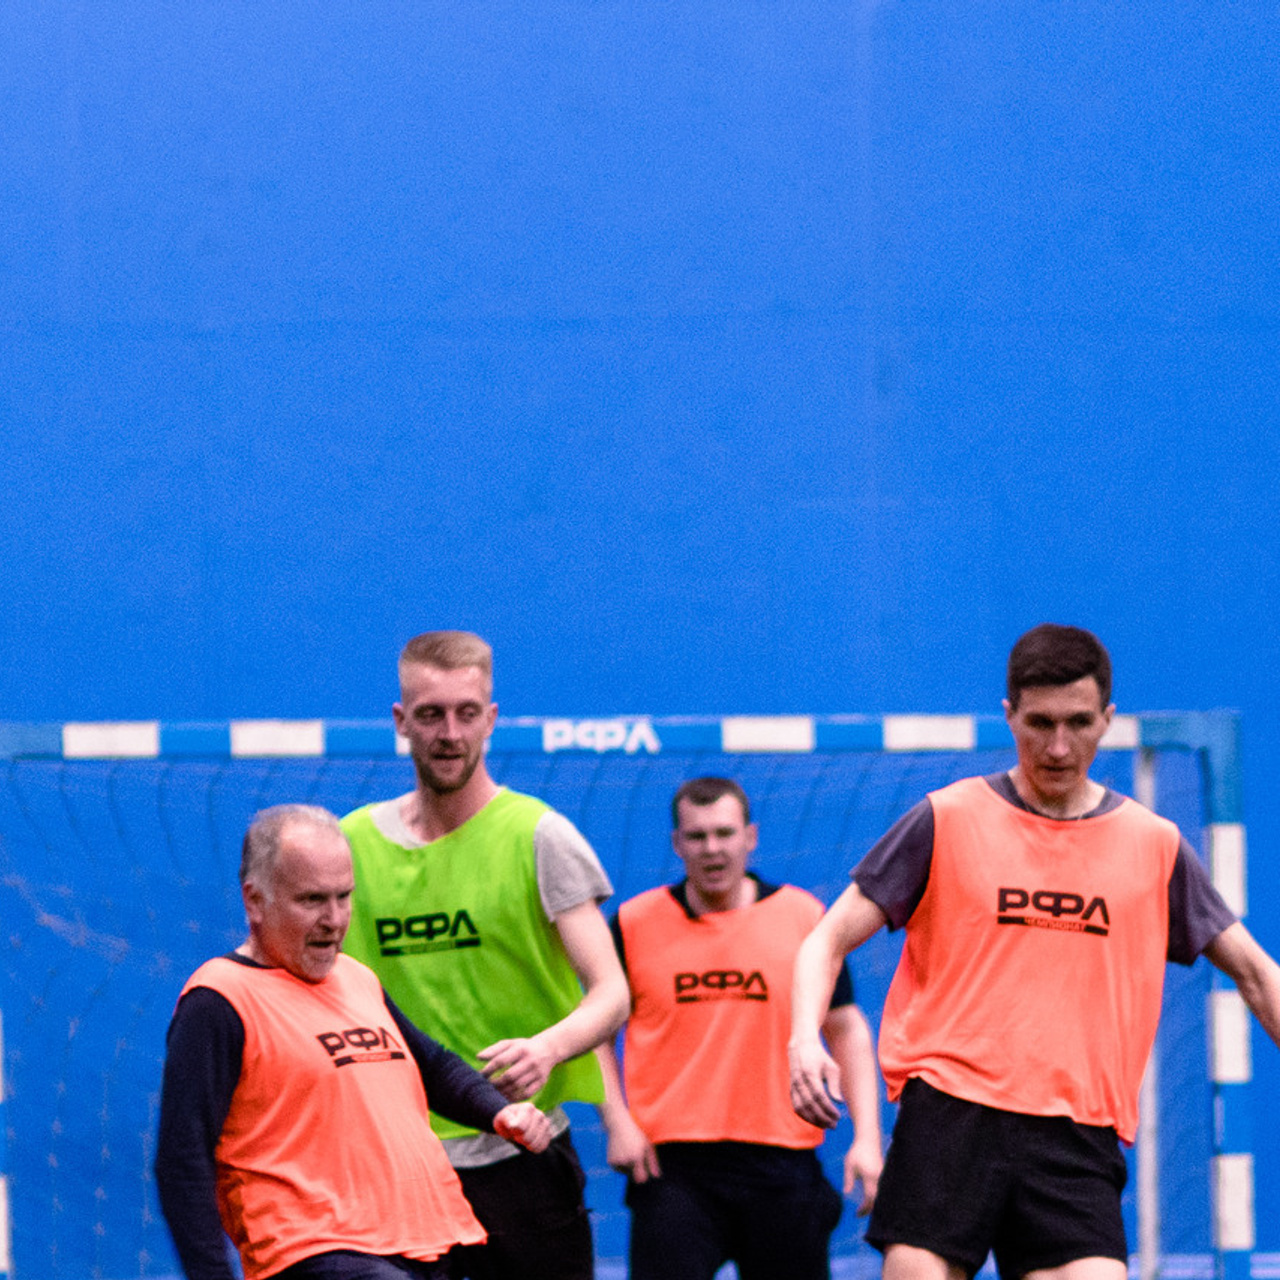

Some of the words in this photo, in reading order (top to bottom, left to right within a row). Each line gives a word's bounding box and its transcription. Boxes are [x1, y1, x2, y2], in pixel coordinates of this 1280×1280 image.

[998, 888, 1110, 925] РФЛ
[376, 909, 479, 945] РФЛ
[675, 970, 768, 994] РФЛ
